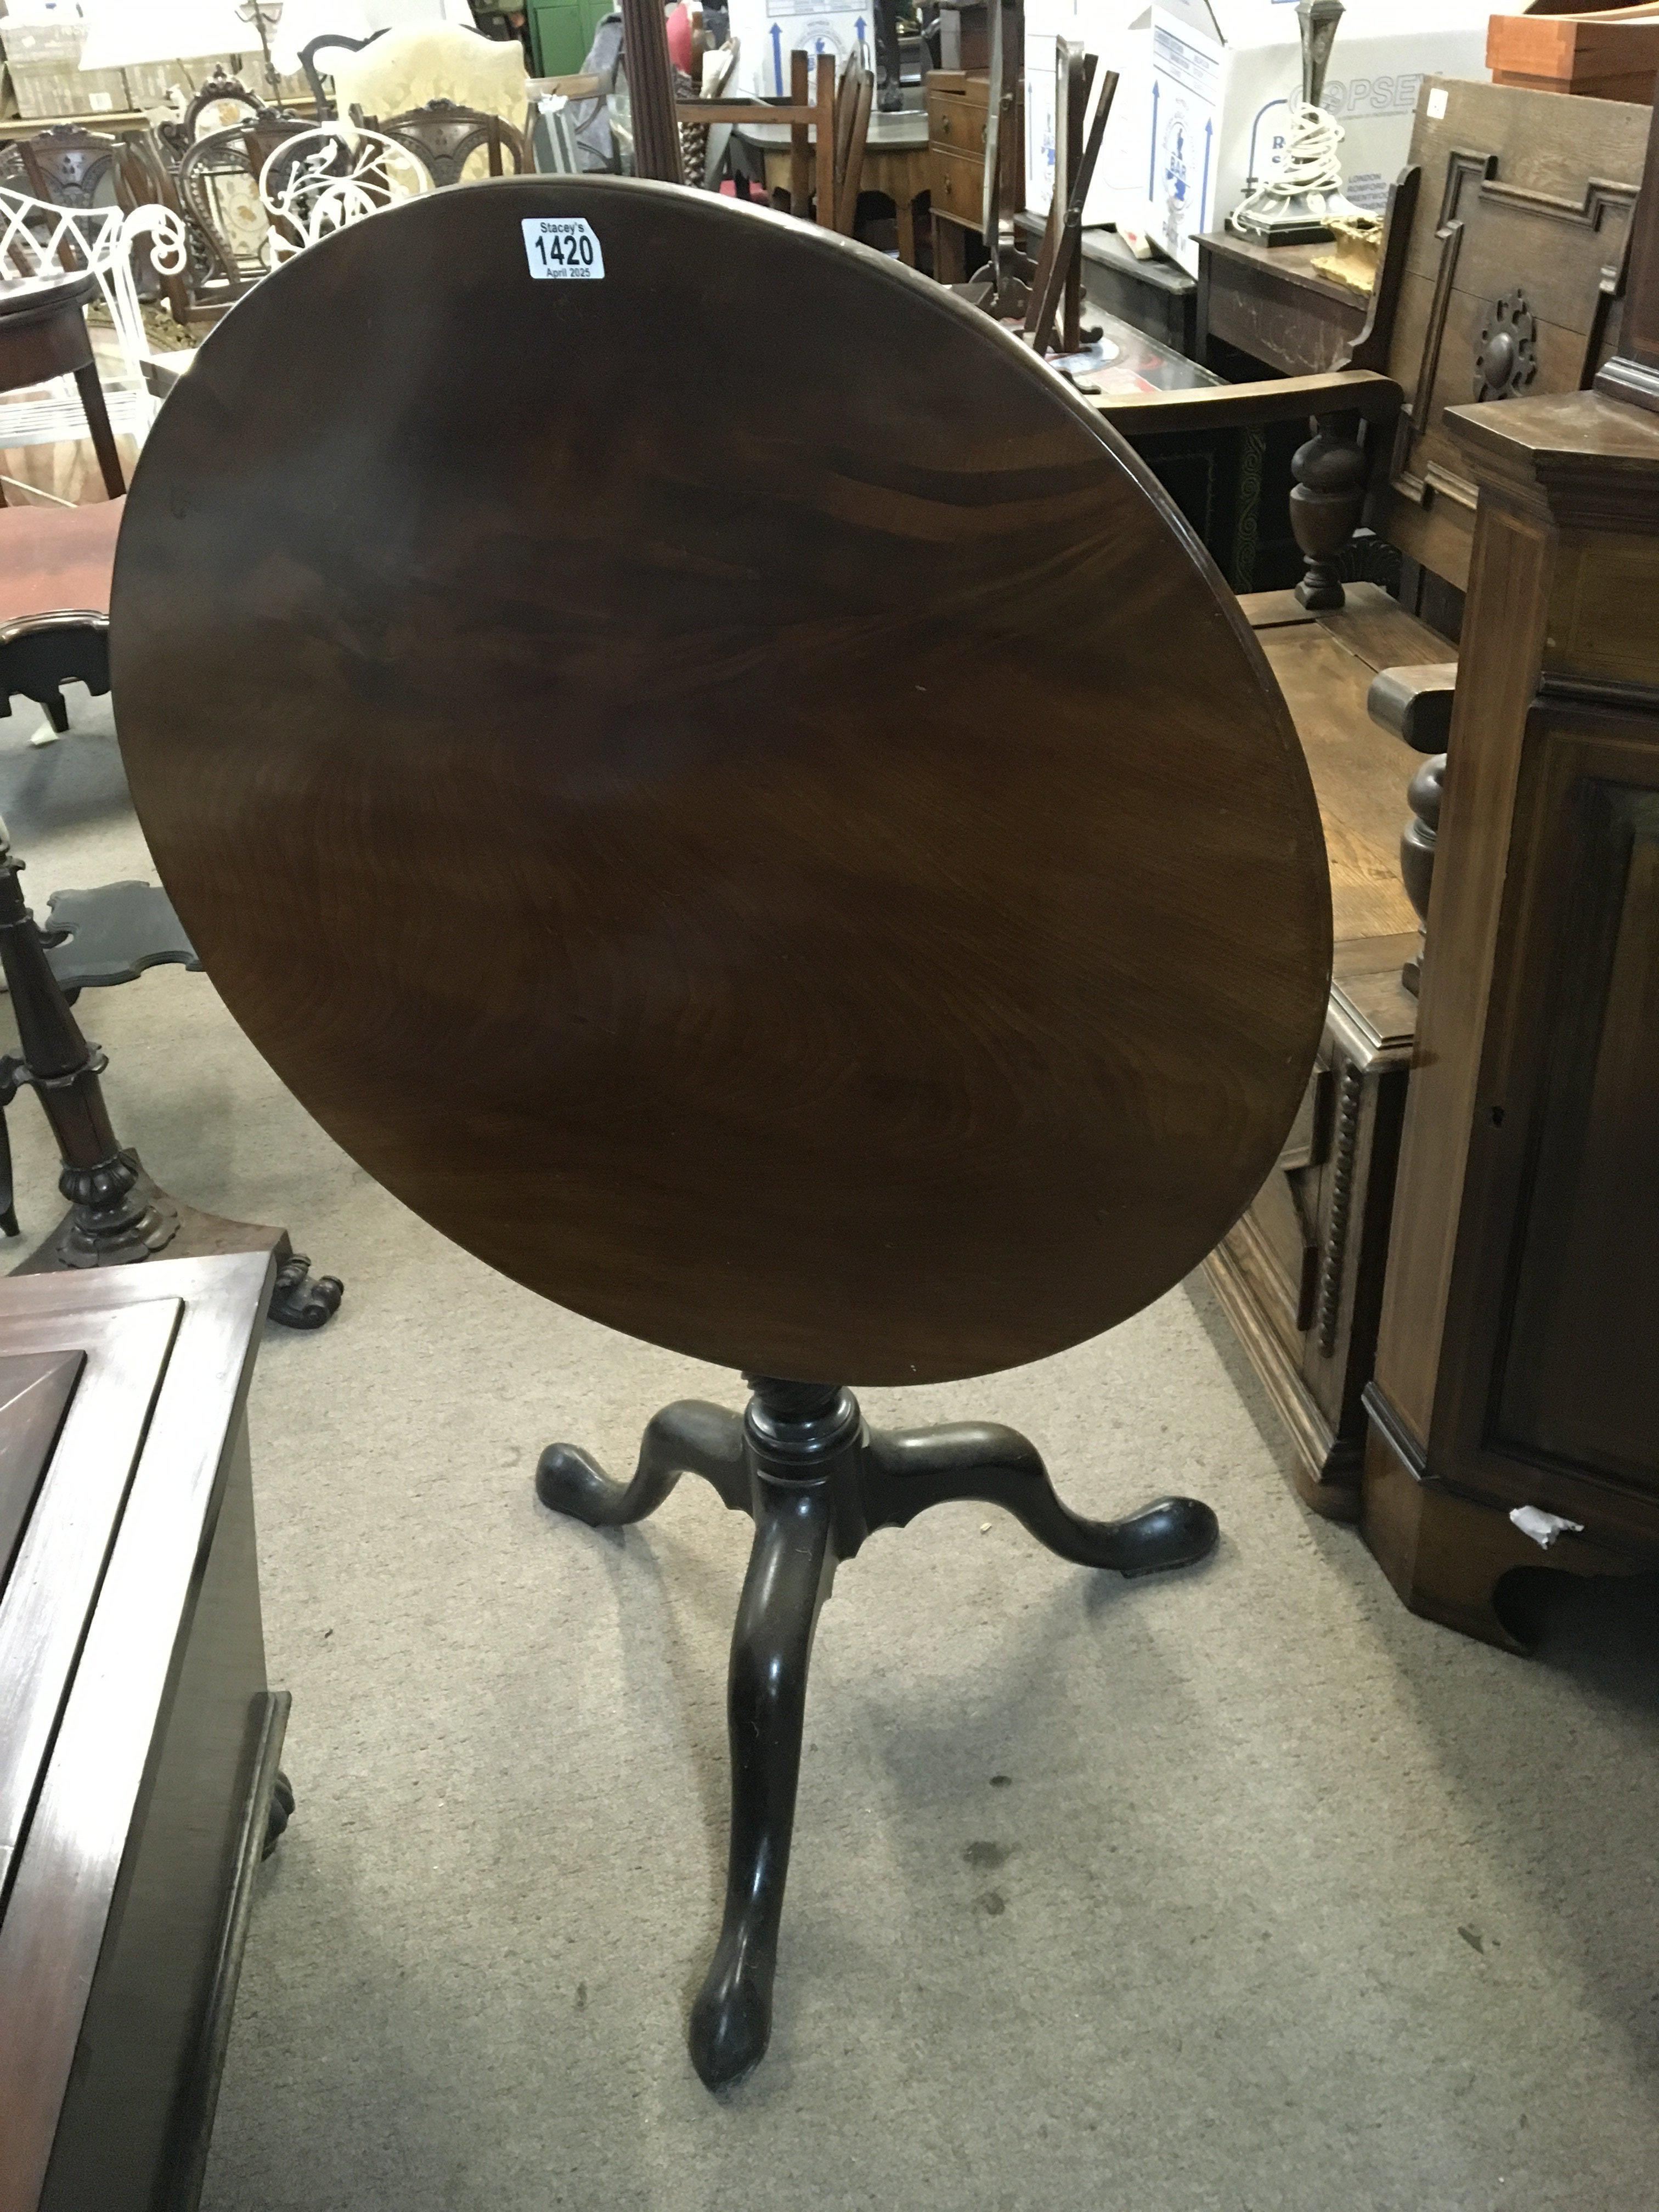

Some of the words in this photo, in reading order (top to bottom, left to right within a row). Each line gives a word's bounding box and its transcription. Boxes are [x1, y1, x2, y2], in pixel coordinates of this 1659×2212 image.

[540, 222, 584, 235] Stacey's
[535, 235, 593, 265] 1420
[546, 268, 567, 279] April
[569, 268, 591, 277] 2025
